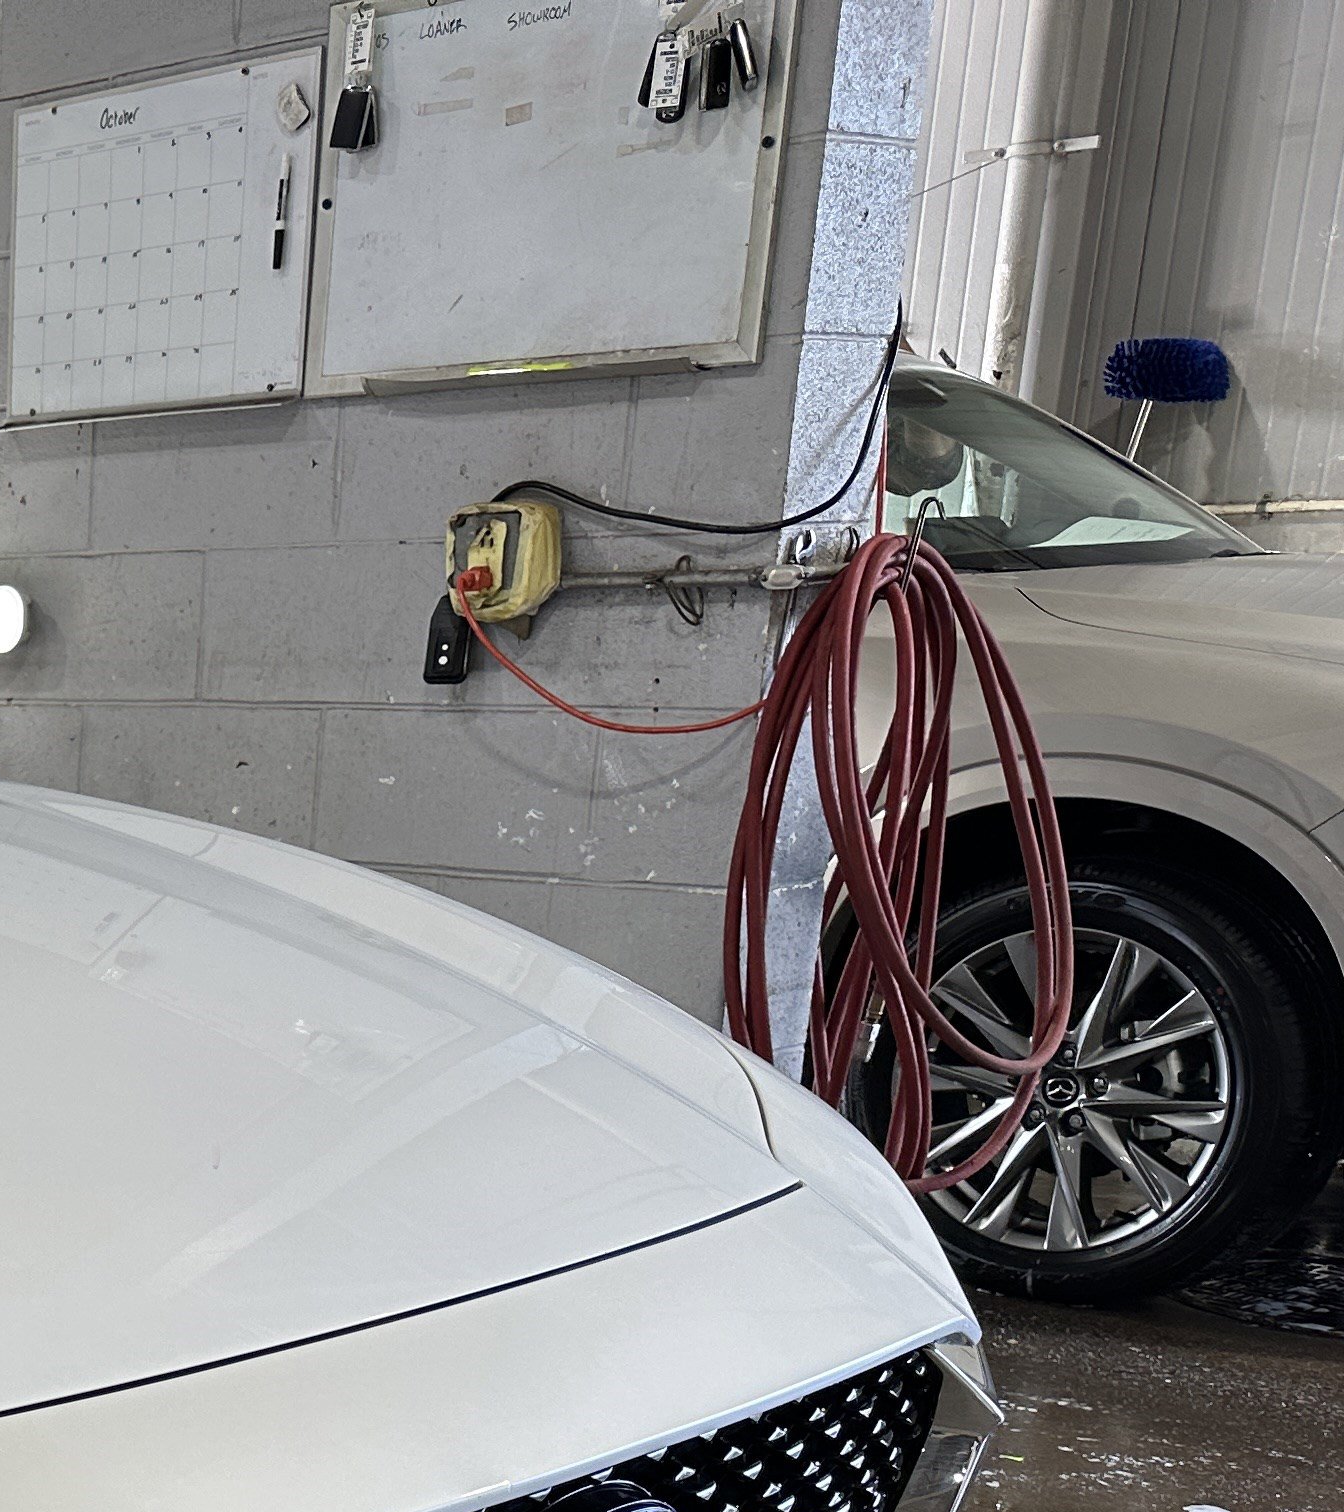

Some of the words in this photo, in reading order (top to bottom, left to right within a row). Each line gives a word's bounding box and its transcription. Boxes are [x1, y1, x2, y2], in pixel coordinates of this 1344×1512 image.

[507, 0, 571, 31] SHOWROOM
[419, 17, 467, 40] LOANER
[99, 106, 140, 130] October
